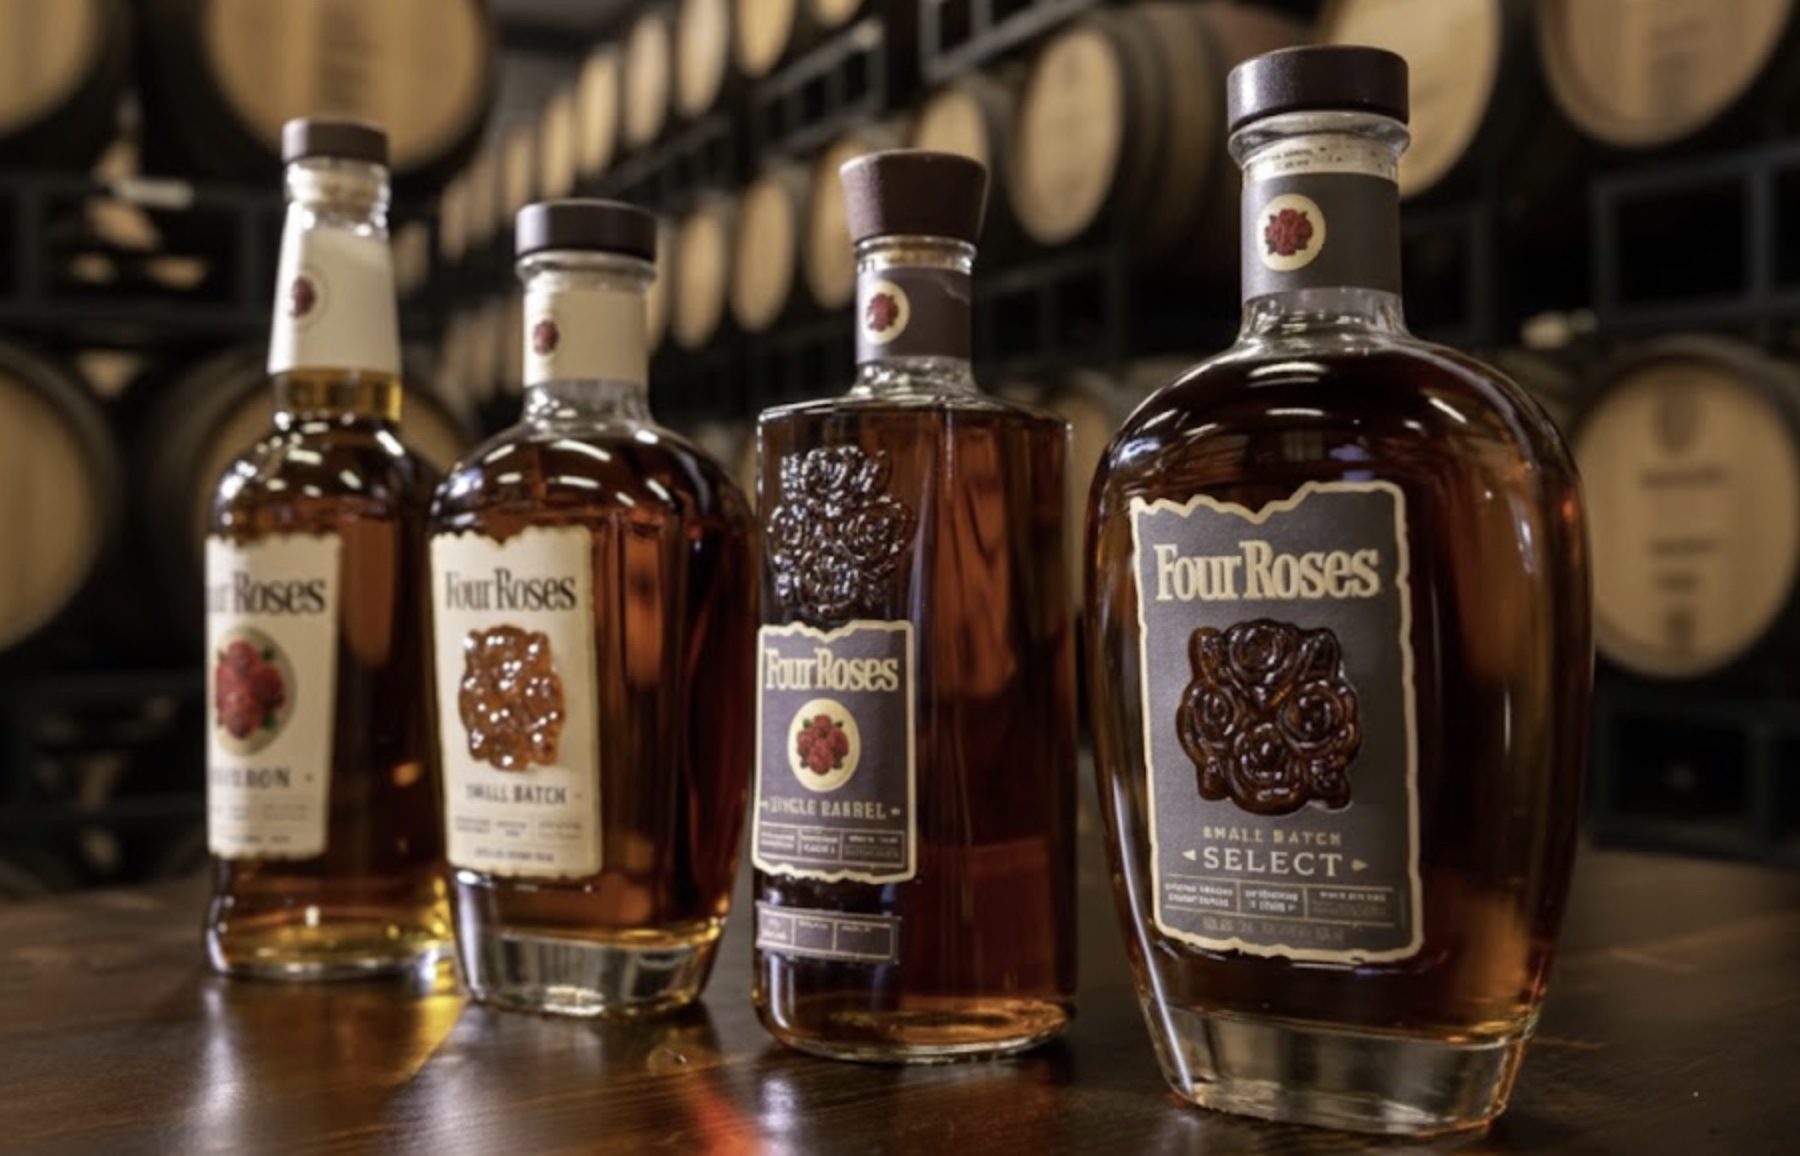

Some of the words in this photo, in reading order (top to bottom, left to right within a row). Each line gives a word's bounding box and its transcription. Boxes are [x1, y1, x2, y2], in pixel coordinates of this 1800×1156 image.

[1153, 543, 1242, 601] Four
[1238, 540, 1380, 600] Roses
[233, 571, 327, 615] Roses
[494, 567, 577, 612] Roses
[765, 648, 817, 690] Four
[813, 648, 899, 691] Roses
[513, 785, 566, 804] BATCH
[821, 800, 887, 820] BARREL
[1203, 826, 1264, 843] SMALL
[1273, 829, 1342, 845] BATCH
[1203, 847, 1343, 877] SELECT
